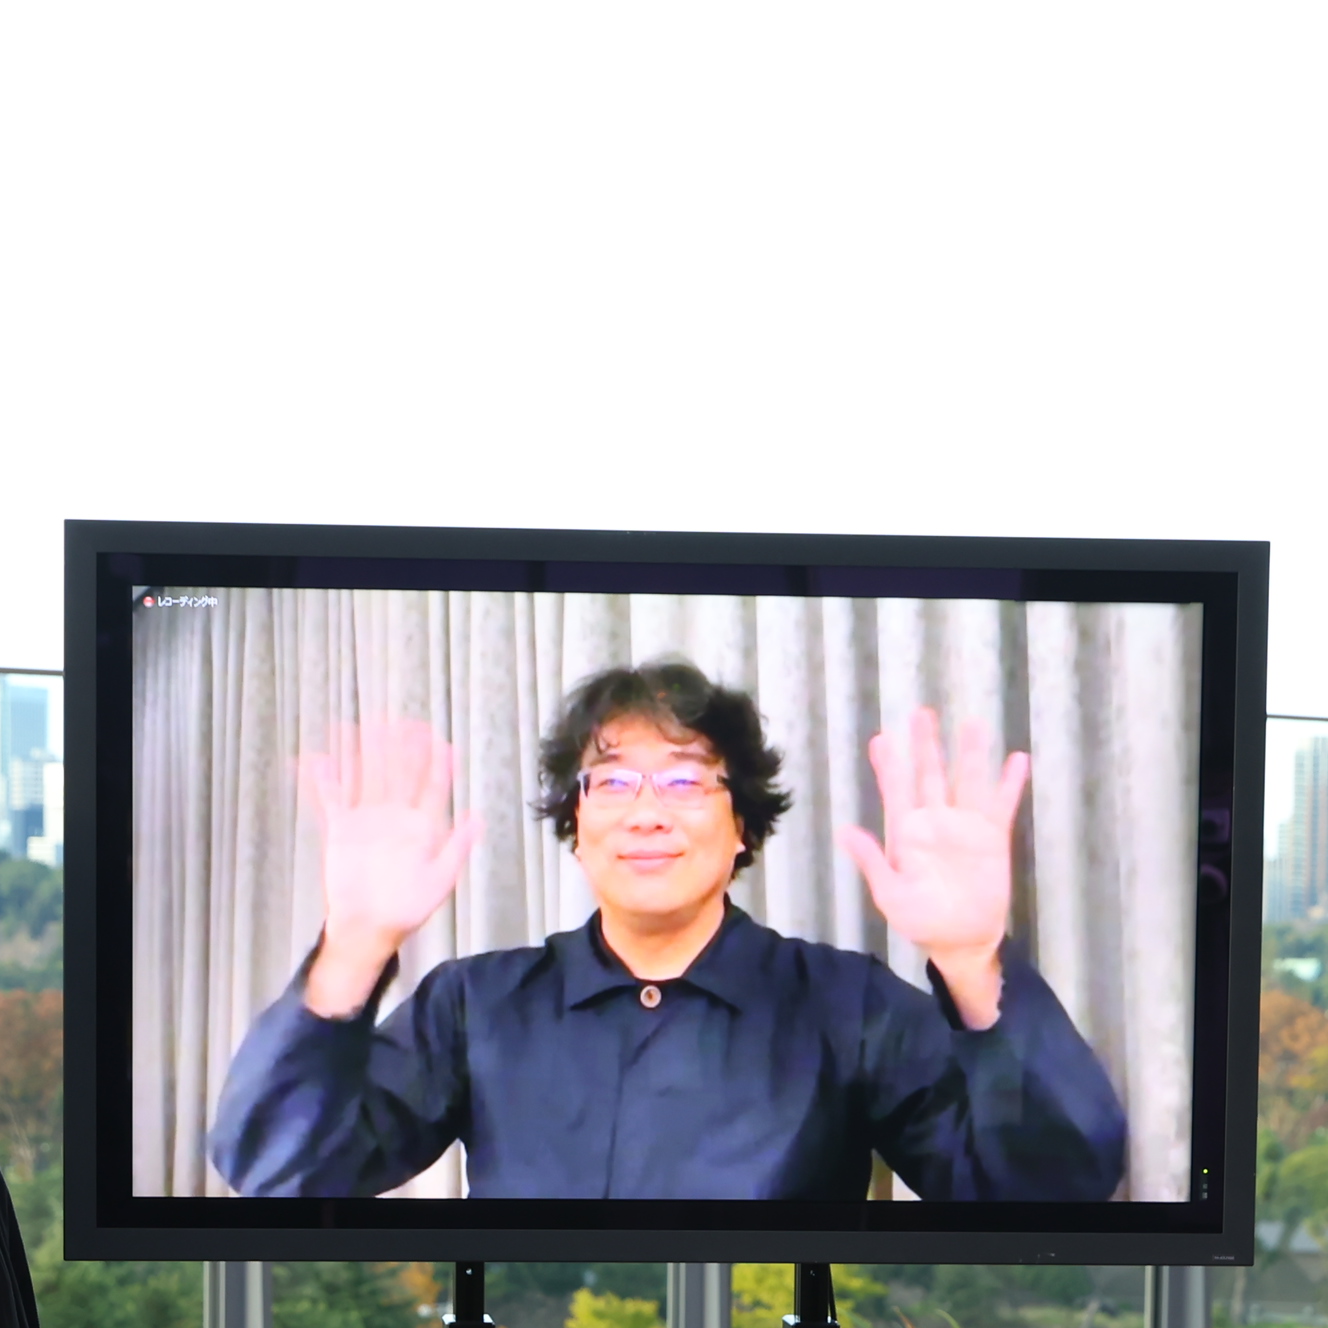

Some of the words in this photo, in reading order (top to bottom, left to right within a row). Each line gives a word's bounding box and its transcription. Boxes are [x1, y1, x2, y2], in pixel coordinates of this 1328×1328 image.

[157, 595, 218, 607] レコーディング中
